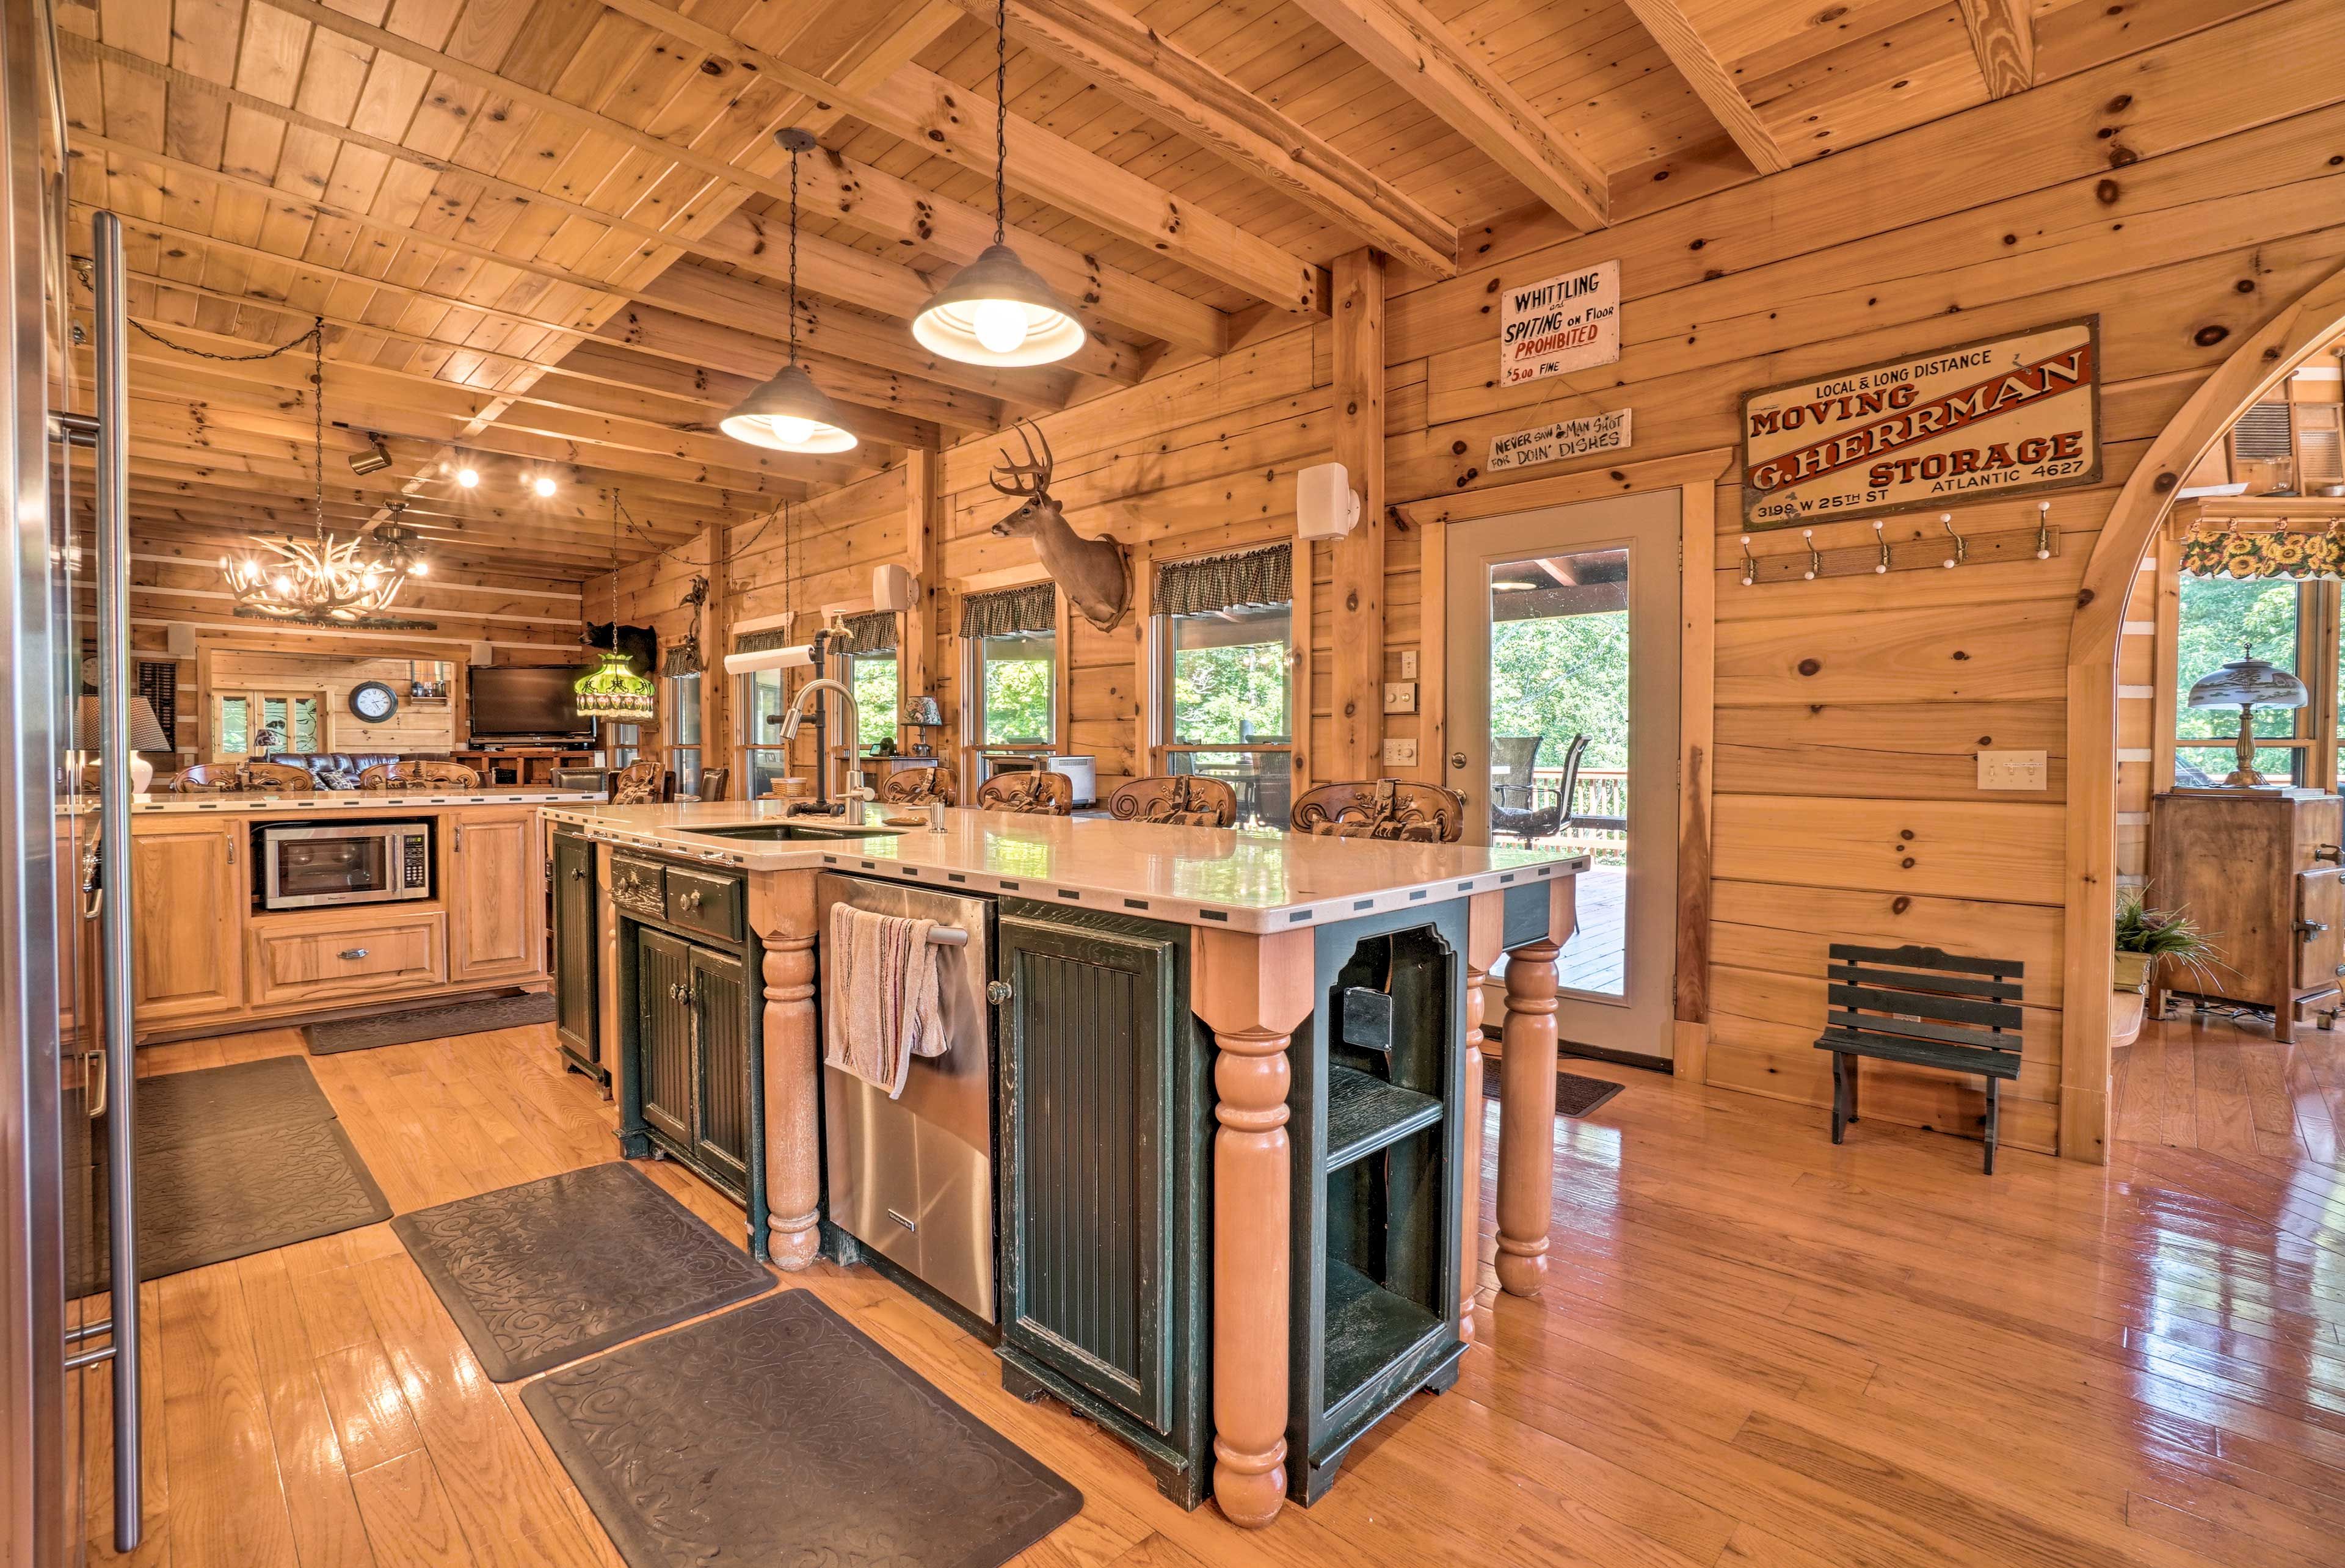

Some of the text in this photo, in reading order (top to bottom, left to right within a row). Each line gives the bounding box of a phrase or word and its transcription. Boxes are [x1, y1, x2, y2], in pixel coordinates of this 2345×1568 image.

[1514, 272, 1599, 313] WHITTLING
[1504, 311, 1563, 344] SPITING
[1515, 324, 1598, 359] PROHIBITED
[1507, 361, 1560, 382] $5.00 FINE
[1816, 350, 1992, 399] LOCAL & LONG DISTANCE
[1750, 383, 1919, 438] MOVING
[1491, 455, 1510, 468] FOR
[1559, 432, 1620, 457] DISHES
[1496, 433, 1532, 455] NEVER
[1534, 427, 1553, 442] SAW
[1565, 421, 1589, 438] MAN
[1593, 415, 1624, 432] SHOT
[1869, 430, 2083, 488] STORAGE
[1800, 500, 1813, 510] W
[1866, 490, 1888, 503] ST
[1931, 470, 2020, 493] ATLANTIC
[2031, 460, 2084, 477] 4627
